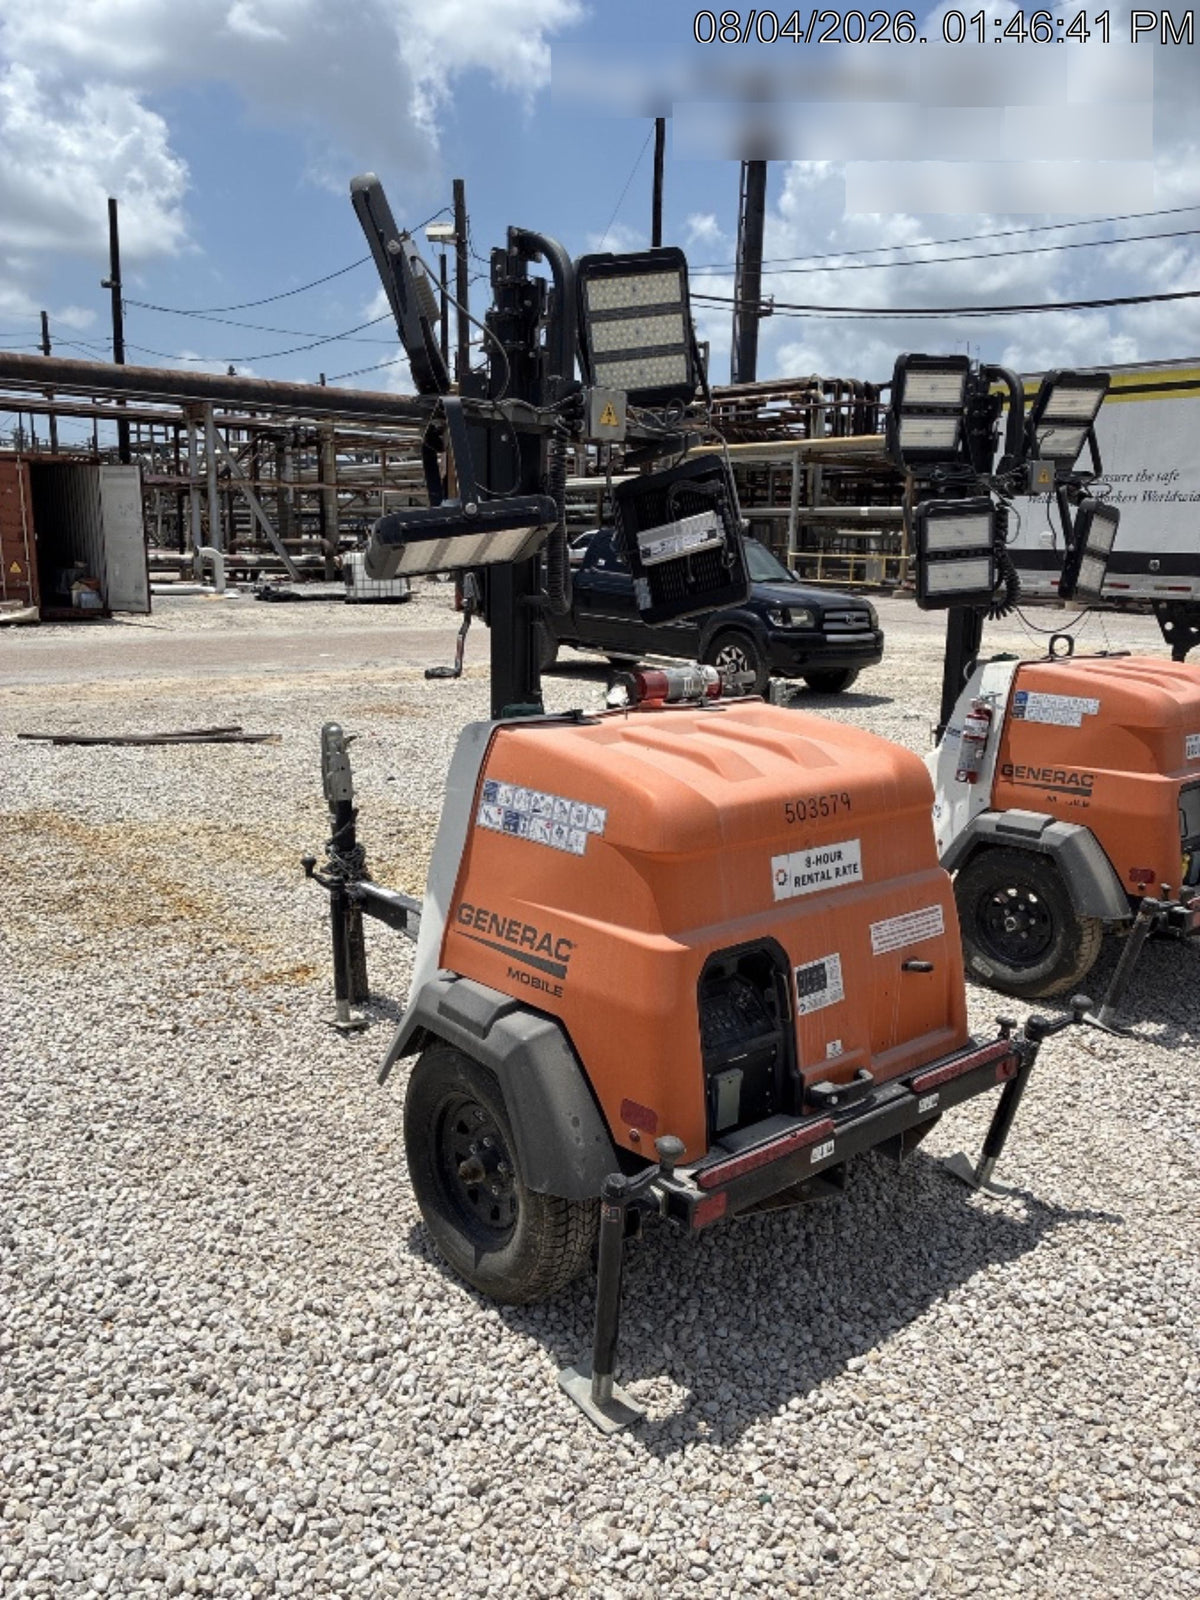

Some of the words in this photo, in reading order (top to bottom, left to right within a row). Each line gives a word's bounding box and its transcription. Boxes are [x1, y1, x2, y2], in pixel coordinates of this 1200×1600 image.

[1102, 473, 1133, 483] nsure
[1135, 469, 1155, 482] the
[1157, 468, 1180, 485] safe
[1001, 764, 1094, 787] GENERAC
[784, 792, 851, 823] 503579
[794, 869, 833, 887] RENTAL
[835, 863, 859, 879] RATE
[456, 902, 572, 962] GENERAC
[507, 967, 564, 998] MOBILE
